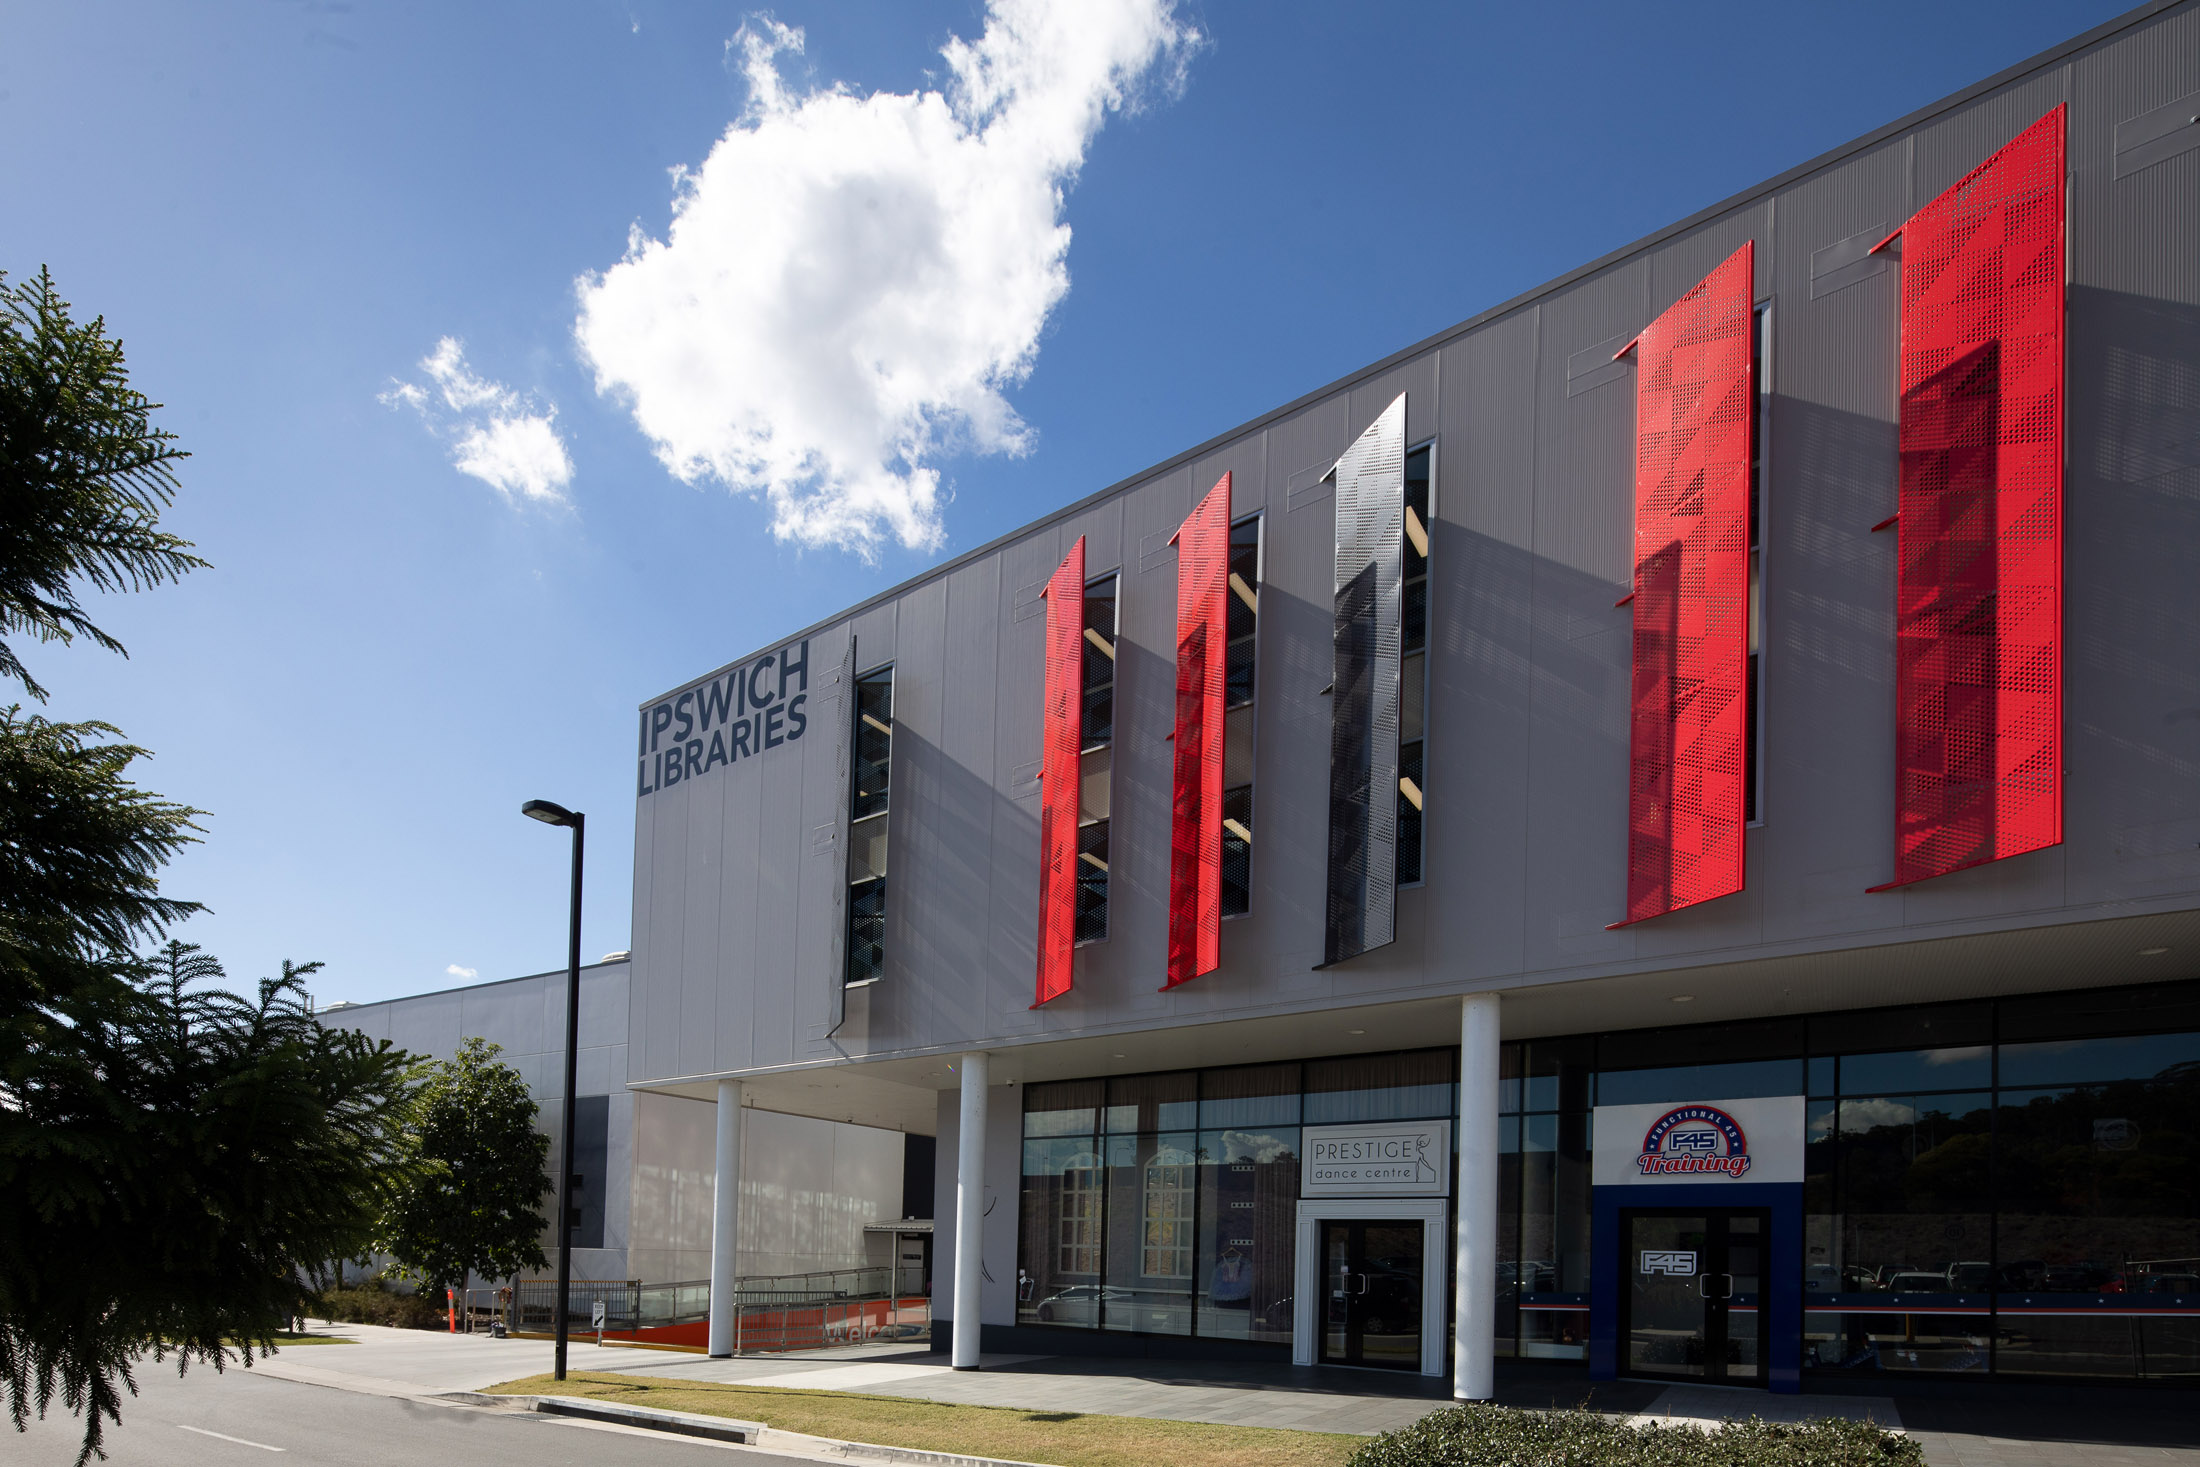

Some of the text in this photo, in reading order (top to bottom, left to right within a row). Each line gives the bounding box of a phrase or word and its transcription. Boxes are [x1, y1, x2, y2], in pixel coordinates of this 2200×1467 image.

[640, 640, 808, 757] IPSWICH
[639, 694, 807, 797] LIBRARIES
[1652, 1110, 1737, 1140] FUNCTIONAL 45
[1315, 1141, 1412, 1160] PRESTIGE
[1669, 1130, 1719, 1151] F45
[1315, 1168, 1411, 1179] dance centre
[1637, 1151, 1751, 1178] Training
[1640, 1250, 1697, 1276] F45
[826, 1320, 894, 1342] Welco
